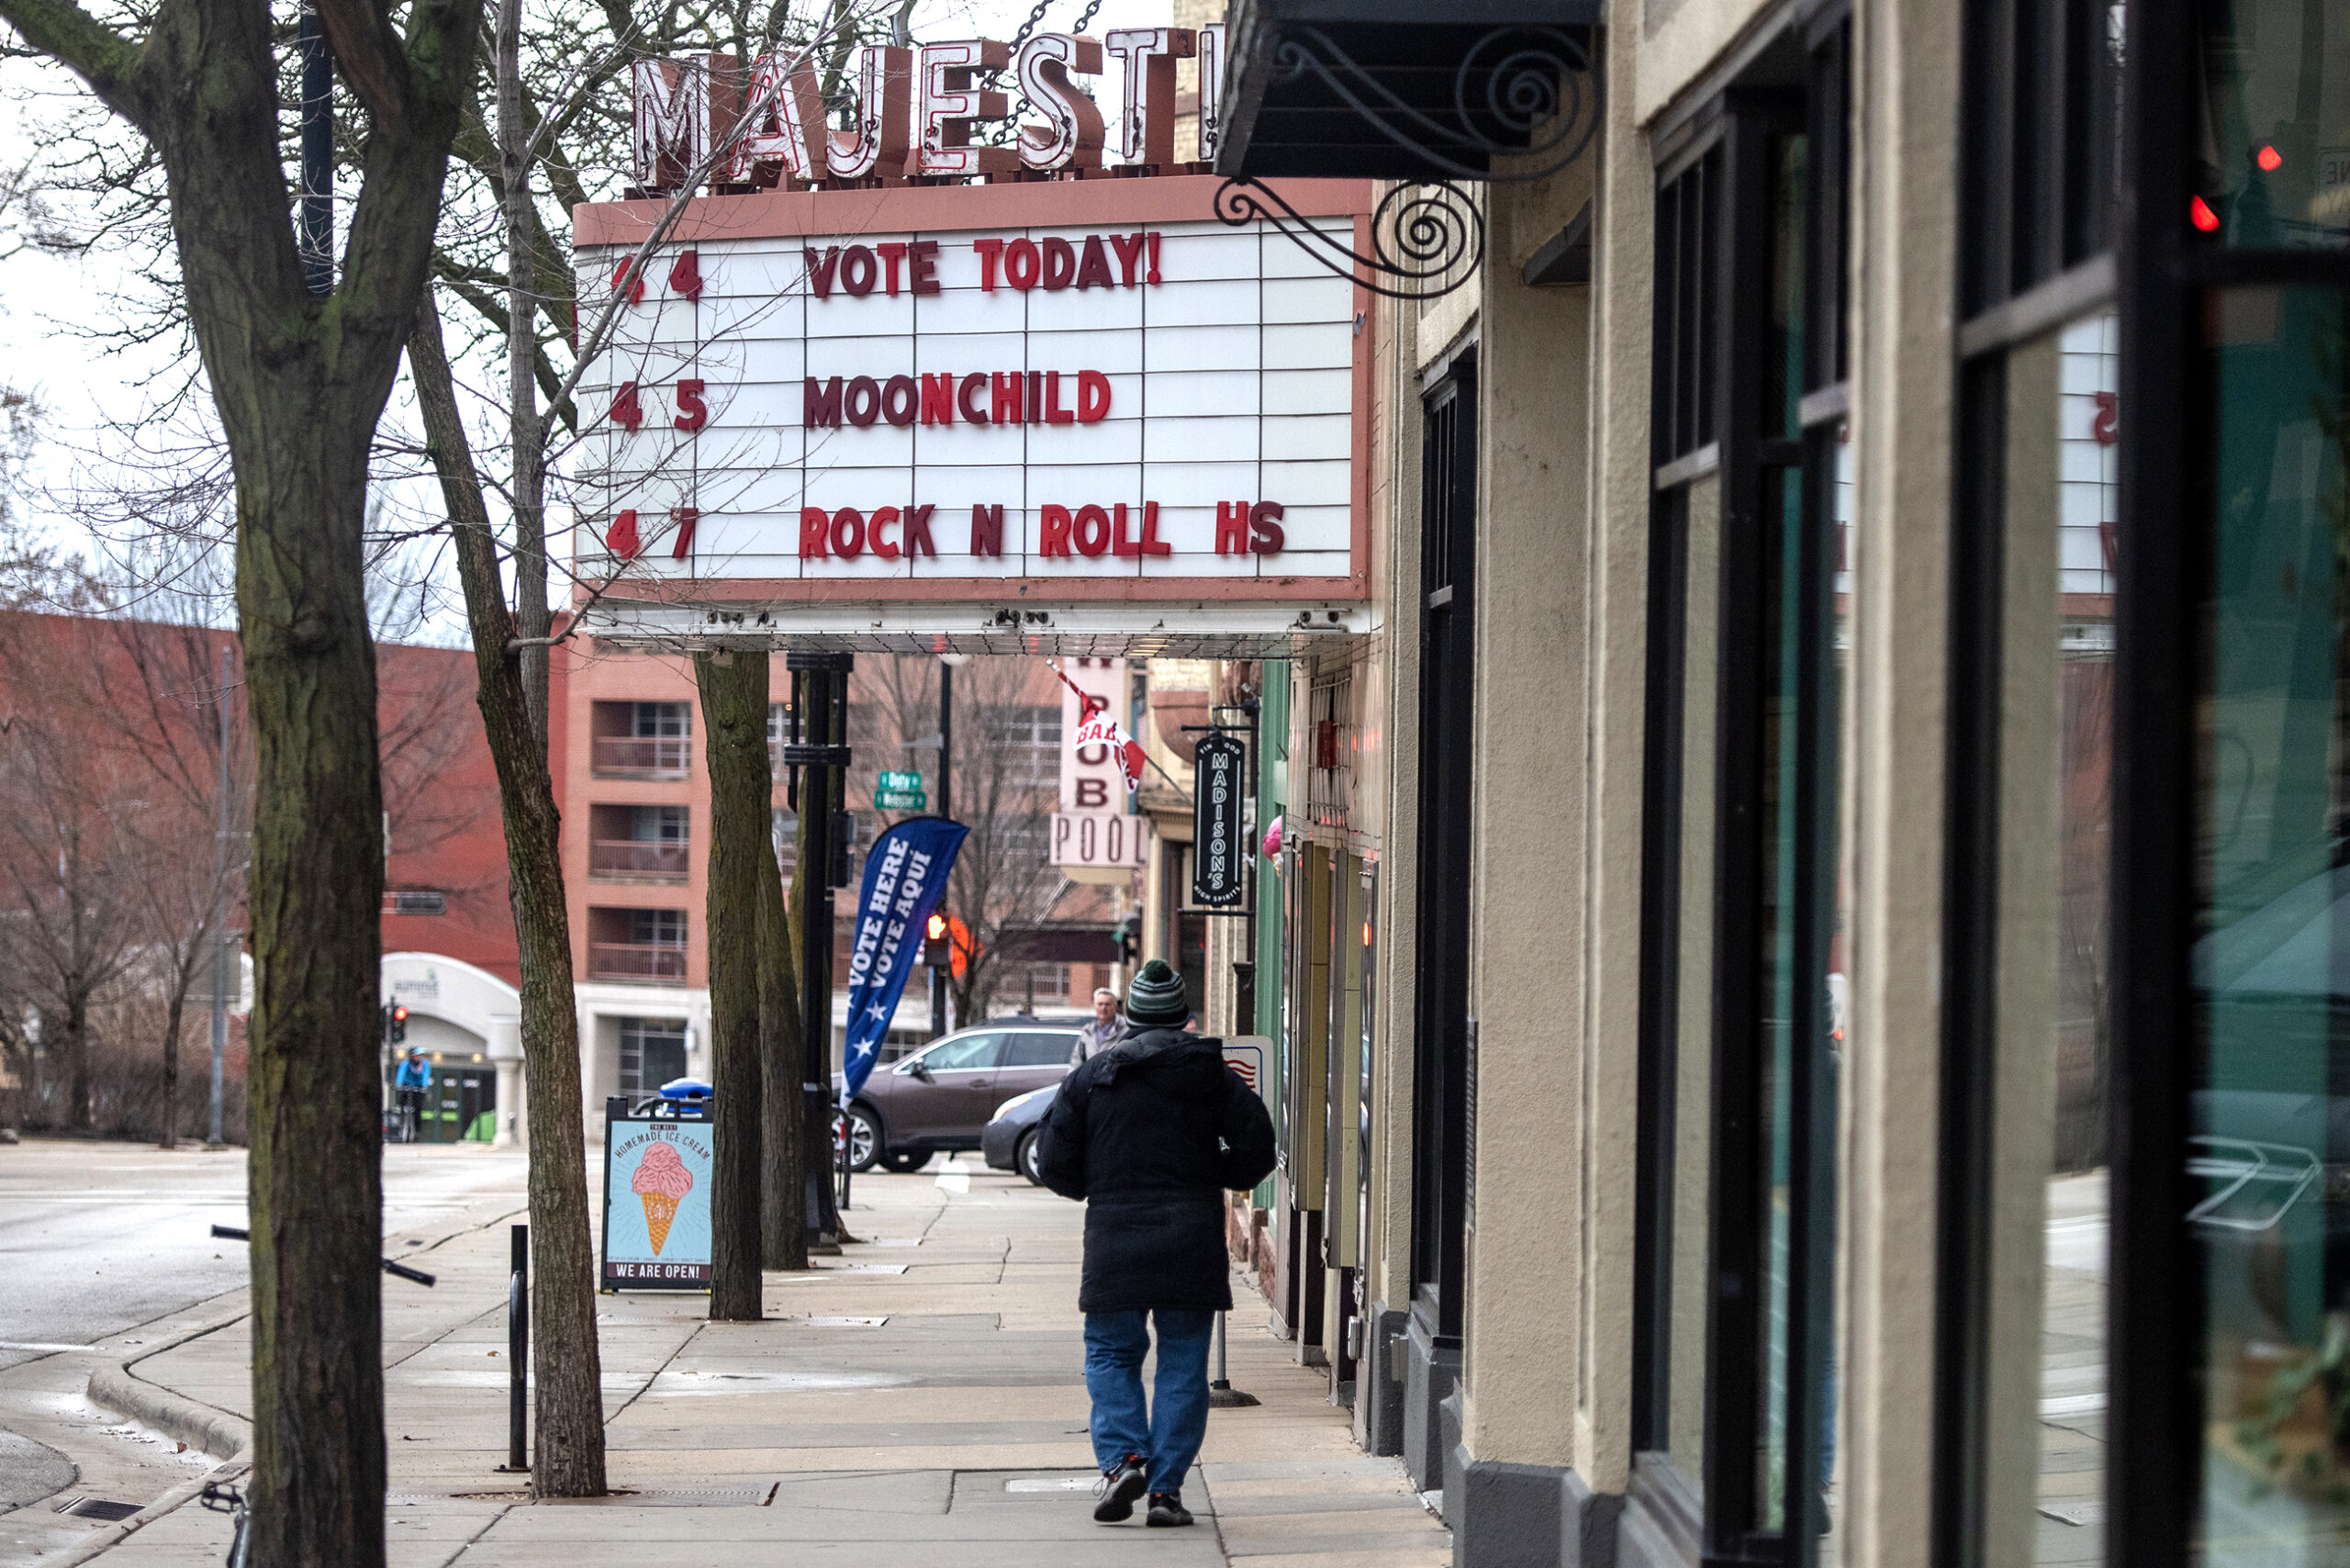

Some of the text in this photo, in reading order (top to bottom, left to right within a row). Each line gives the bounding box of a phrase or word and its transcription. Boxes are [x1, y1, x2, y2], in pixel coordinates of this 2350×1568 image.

[669, 250, 703, 302] 4
[804, 240, 941, 299] VOTE
[973, 231, 1161, 292] TODAY!
[610, 369, 1112, 432] 4 5 MOONCHILD
[606, 499, 1285, 560] 4 7 ROCK N ROLL HS
[1057, 817, 1146, 862] POOL
[1206, 753, 1229, 890] MADISON'S
[848, 836, 909, 987] VOTE HERE
[869, 849, 932, 988] VOTE AQUÍ
[1193, 884, 1240, 902] HIGH SPIRITS
[614, 1131, 711, 1159] HOMEMADE ICE CREAM
[616, 1263, 699, 1279] WE ARE OPEN!
